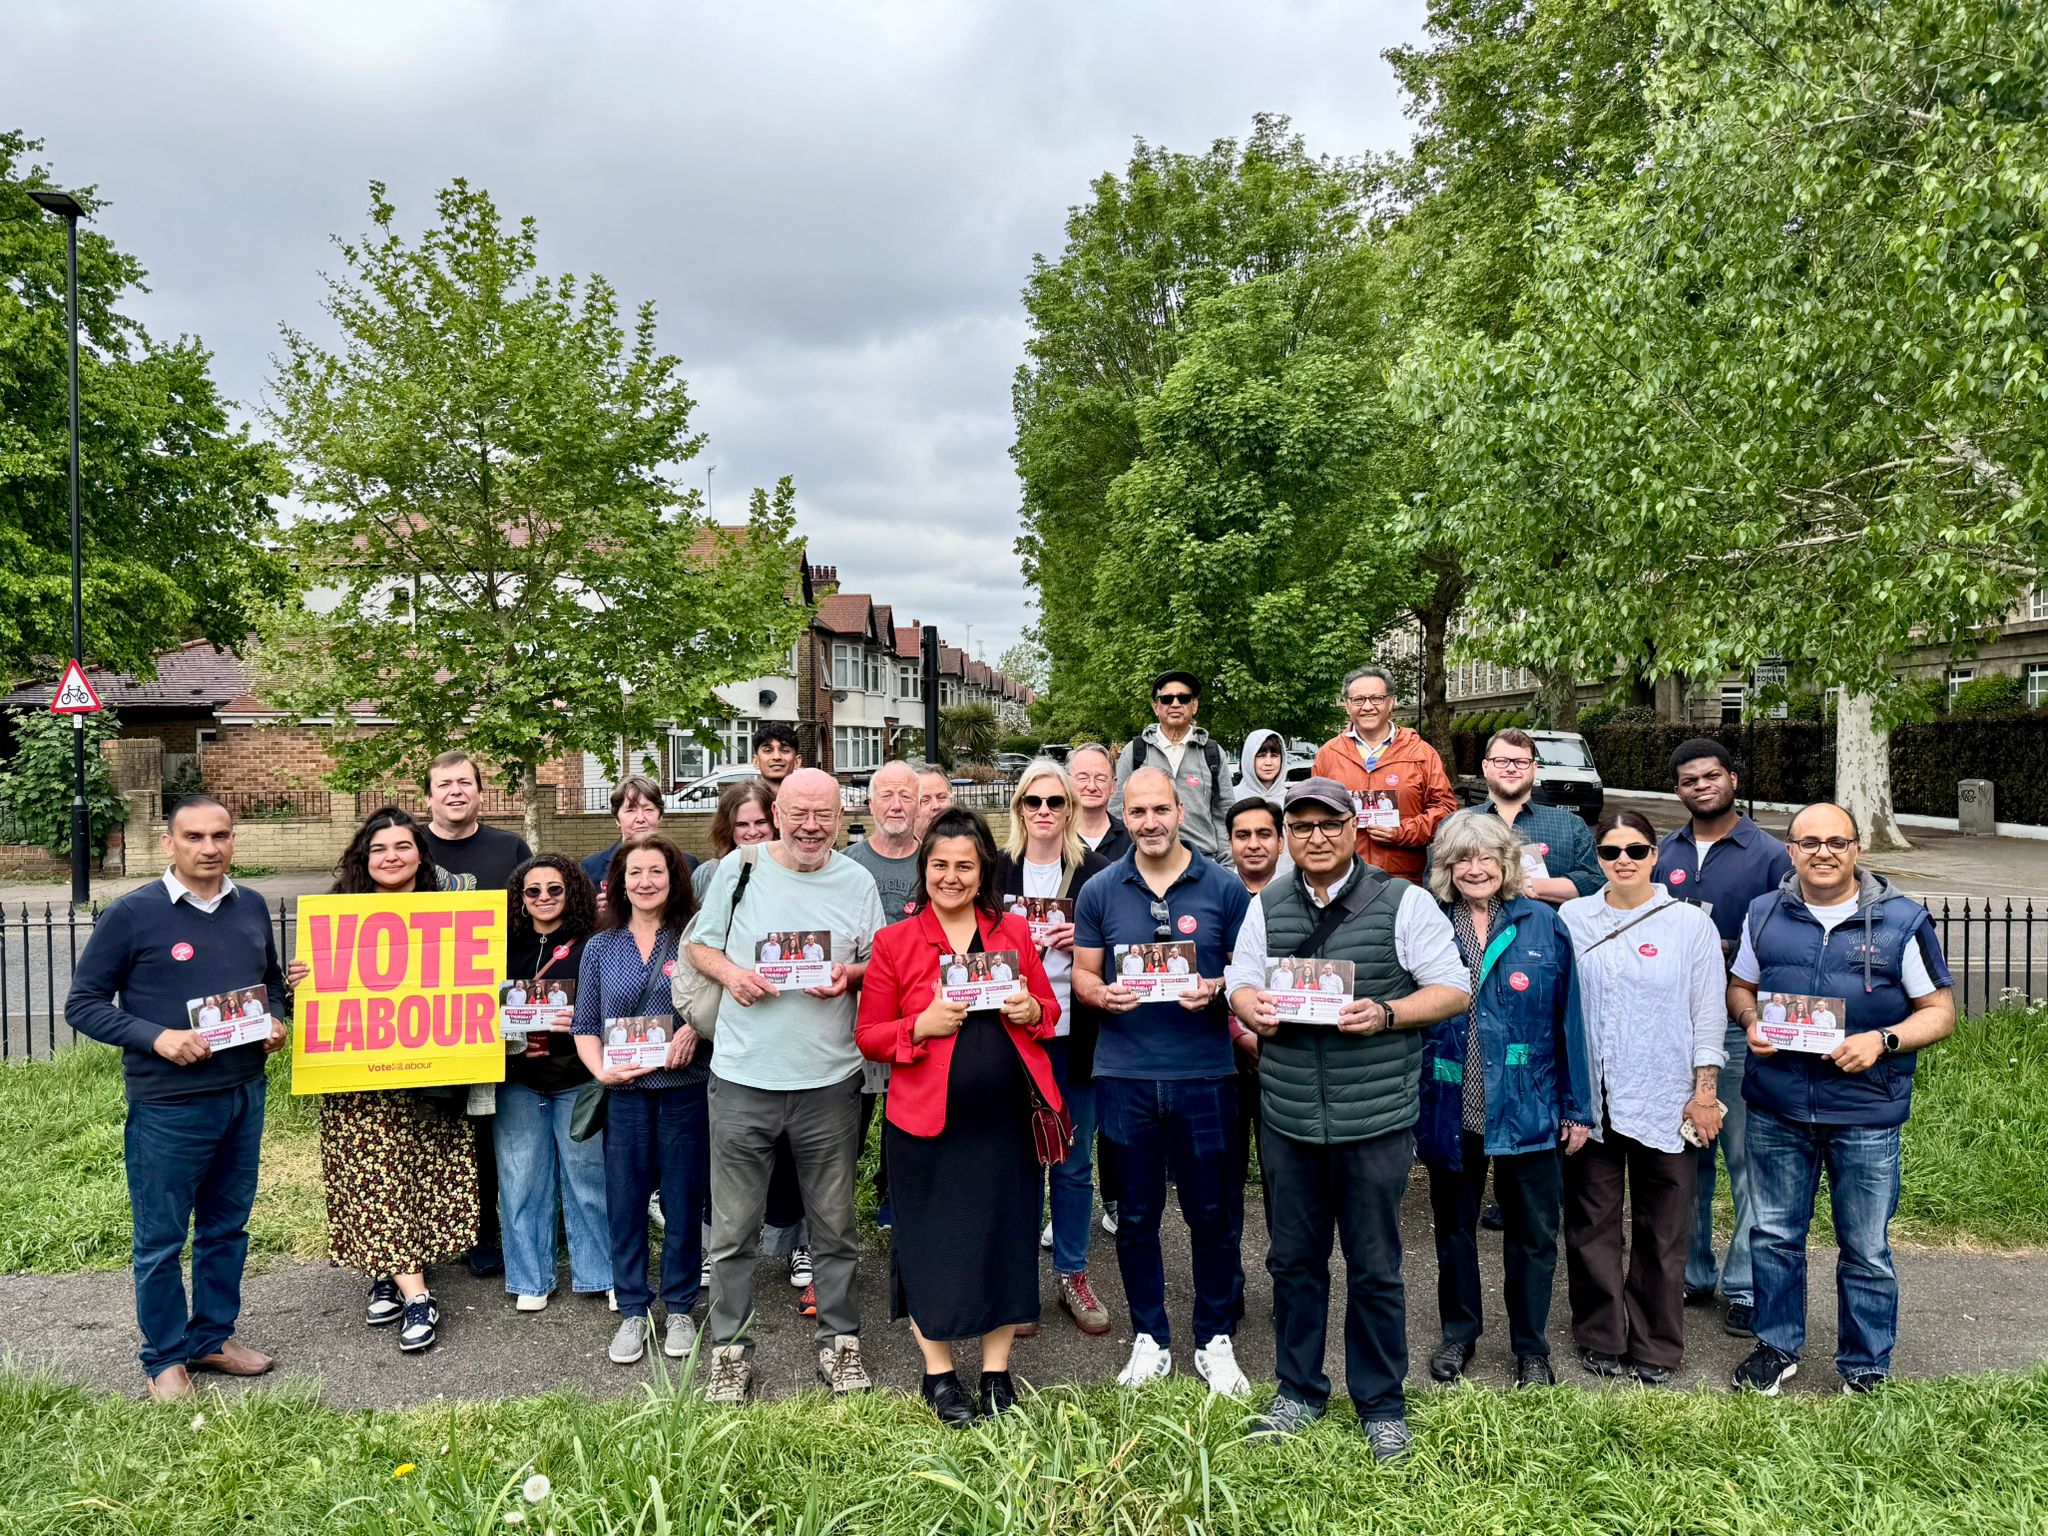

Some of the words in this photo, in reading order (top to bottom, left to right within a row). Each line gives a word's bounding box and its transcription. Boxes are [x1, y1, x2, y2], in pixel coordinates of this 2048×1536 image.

[309, 910, 495, 993] VOTE
[961, 988, 981, 996] LABOUR
[305, 993, 495, 1053] LABOUR
[202, 1029, 215, 1038] VOTE
[215, 1026, 235, 1035] LABOUR
[367, 1064, 392, 1073] Vote
[400, 1062, 432, 1071] Labour
